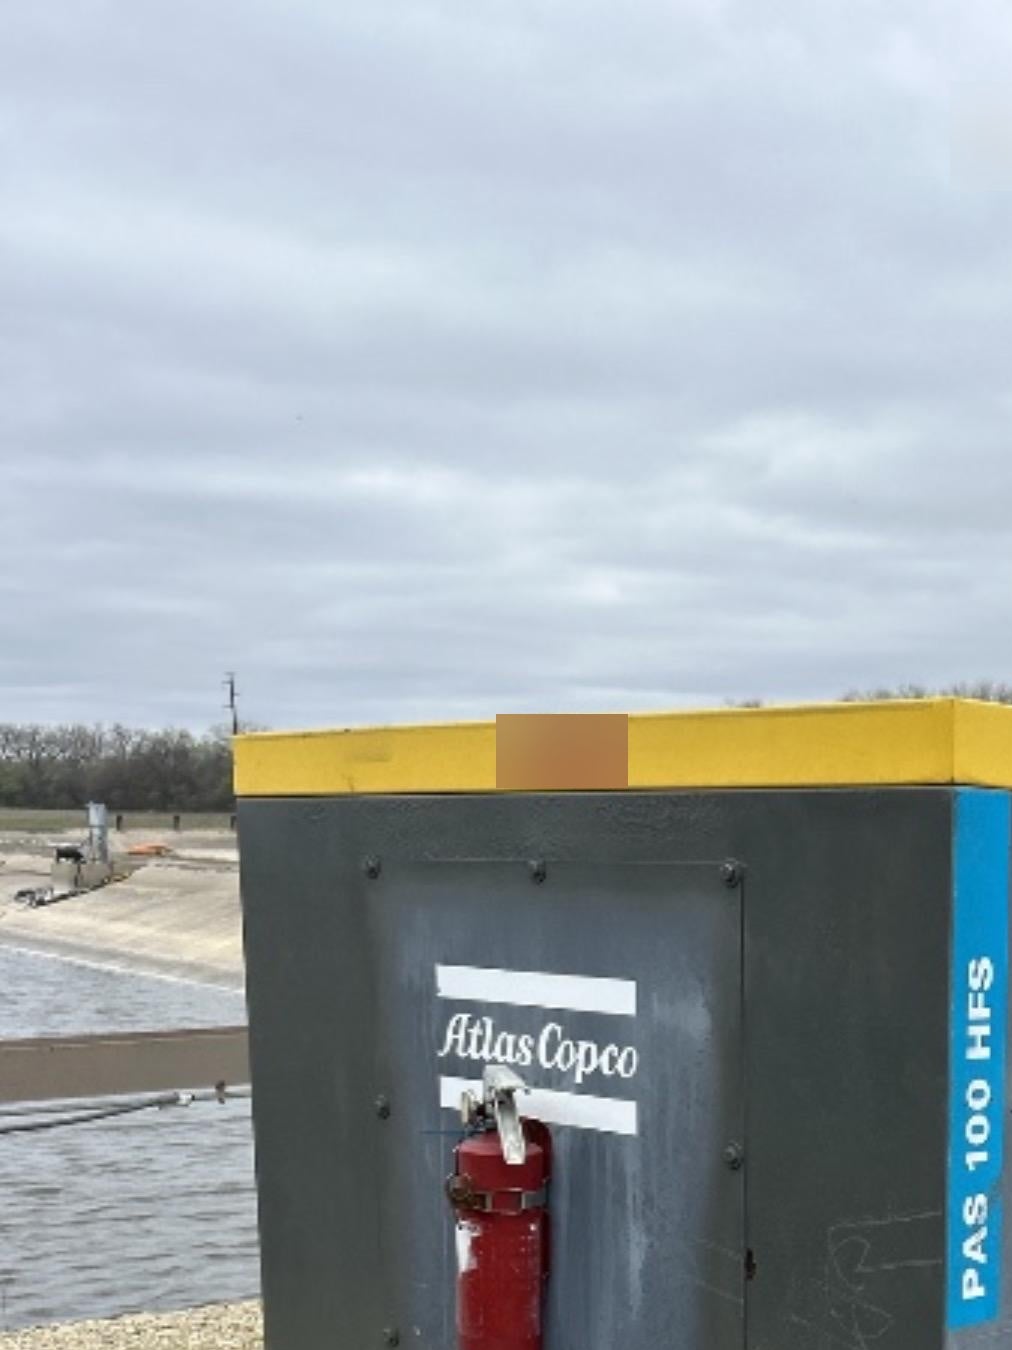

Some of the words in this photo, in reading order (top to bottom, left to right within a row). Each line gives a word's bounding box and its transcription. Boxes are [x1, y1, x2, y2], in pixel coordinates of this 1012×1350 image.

[436, 1013, 534, 1066] Atlas
[537, 1022, 638, 1084] Copco
[965, 955, 996, 1060] HFS
[964, 1078, 993, 1171] 100
[961, 1193, 990, 1300] PAS
